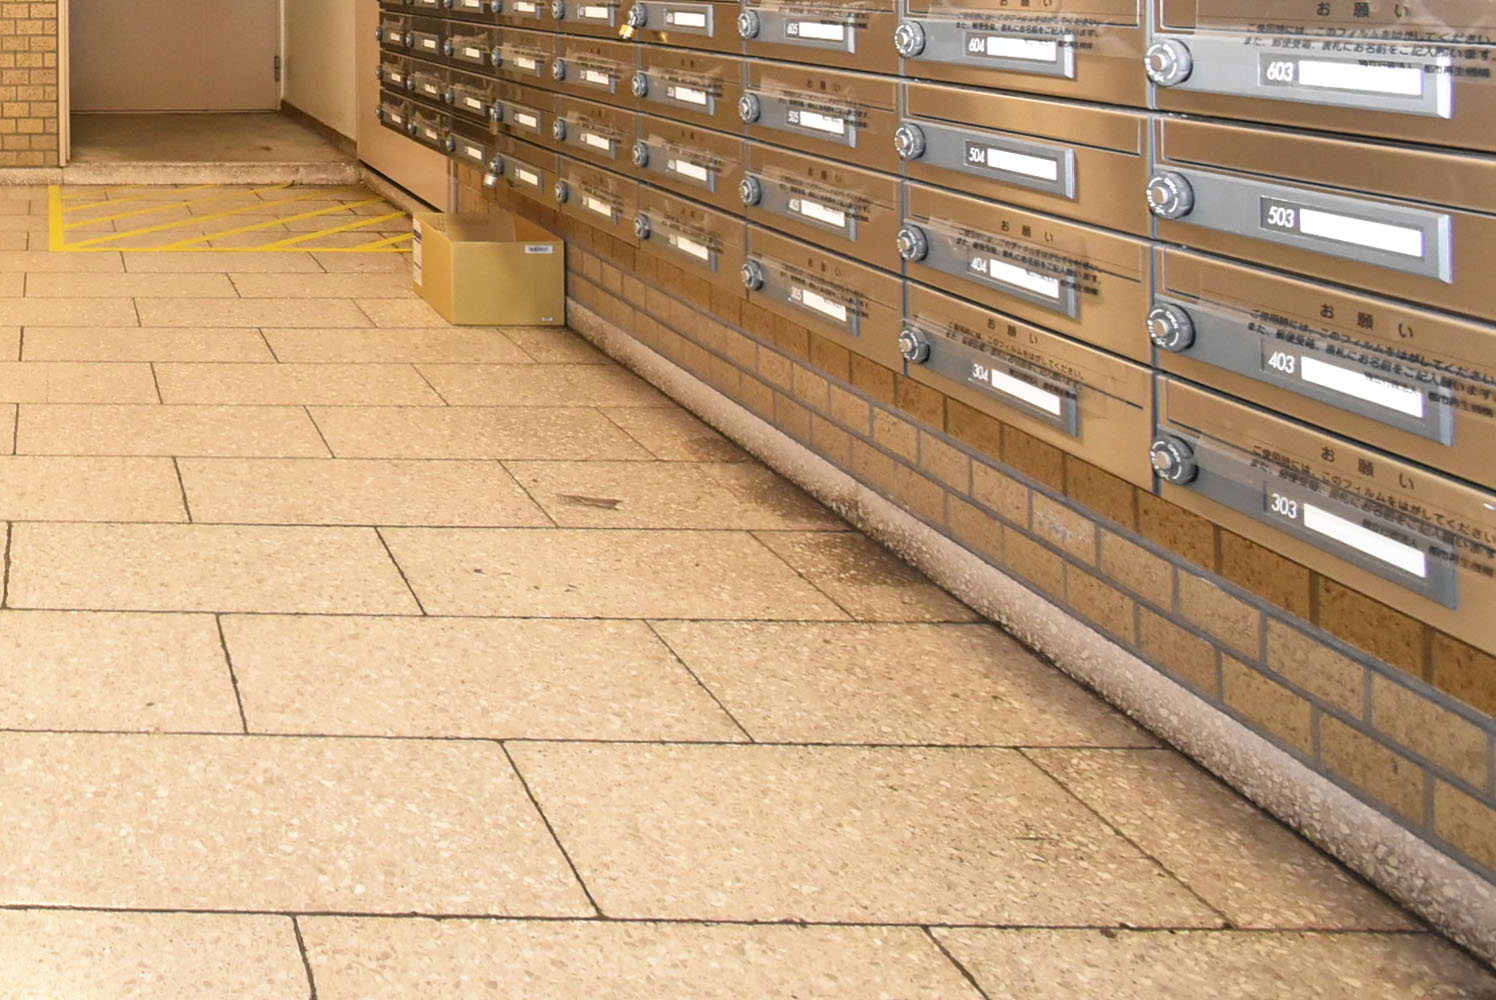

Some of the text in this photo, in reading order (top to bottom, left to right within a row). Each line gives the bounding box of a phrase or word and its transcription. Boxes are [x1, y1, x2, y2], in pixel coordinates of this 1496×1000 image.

[1316, 1, 1410, 18] お願い
[968, 38, 985, 53] 604
[1267, 61, 1294, 81] 603
[968, 148, 985, 163] 504
[1163, 177, 1179, 196] OPEN
[1267, 206, 1295, 228] 503
[971, 256, 987, 273] 404
[1165, 310, 1179, 330] OPEN
[1320, 303, 1414, 339] お願い
[972, 364, 989, 382] 304
[1269, 352, 1295, 374] 403
[1167, 443, 1181, 463] OPEN
[1321, 446, 1415, 491] お願い
[1271, 493, 1297, 519] 303
